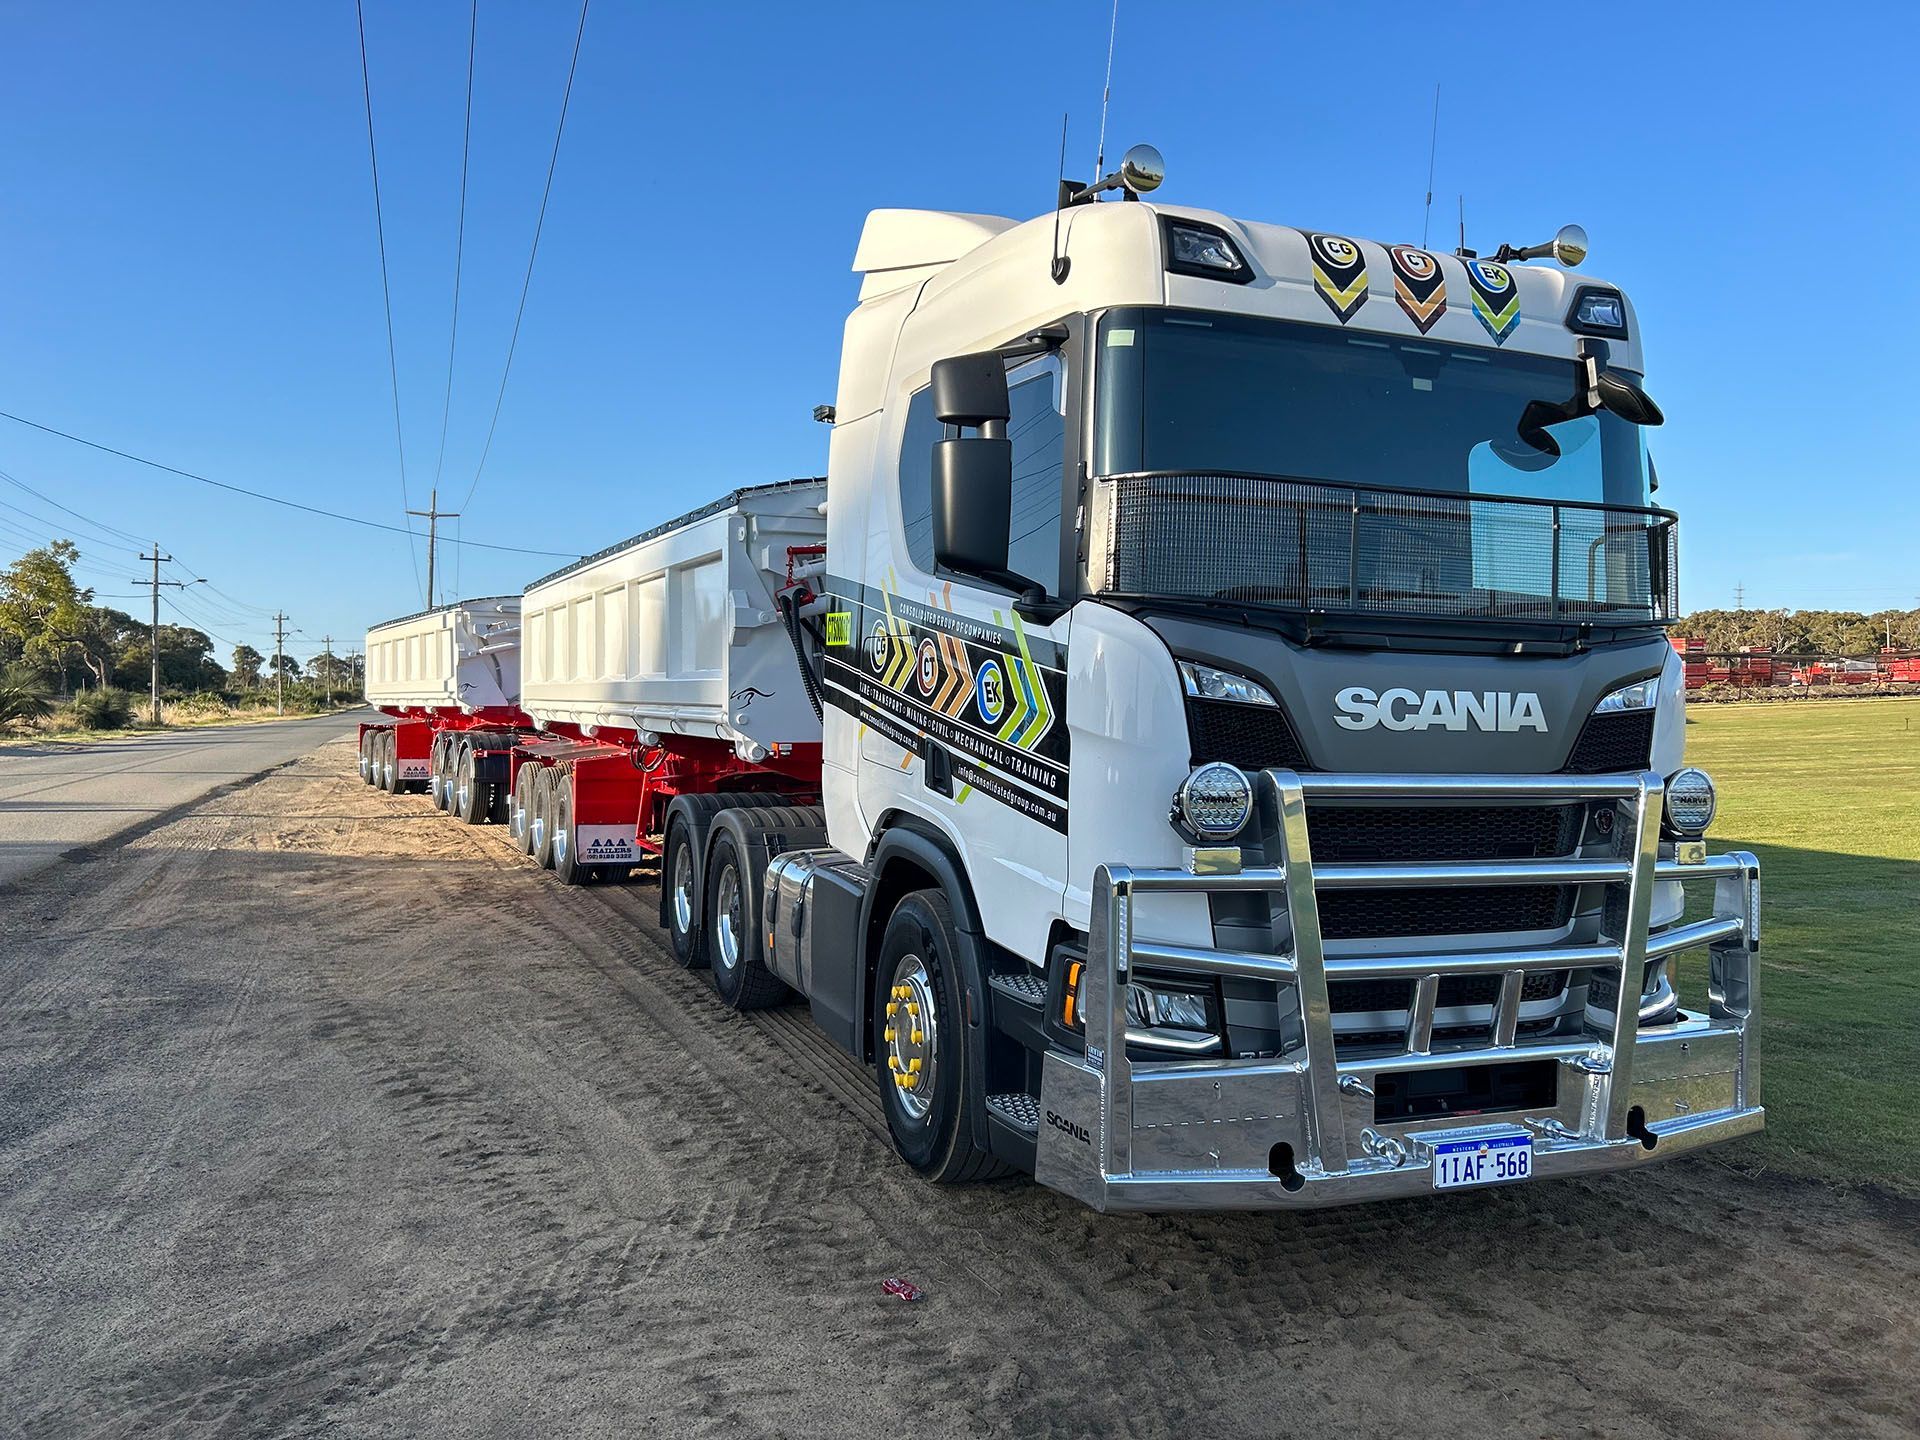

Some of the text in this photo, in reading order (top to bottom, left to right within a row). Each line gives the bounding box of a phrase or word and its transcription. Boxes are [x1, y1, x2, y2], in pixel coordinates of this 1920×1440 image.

[1328, 241, 1352, 256] CG
[1406, 253, 1429, 268] CT
[1481, 266, 1505, 281] EK
[899, 602, 1002, 645] CONSOLIDATED GROUP OF COMPANIES
[875, 637, 886, 655] CG
[923, 656, 935, 677] CT
[983, 681, 1002, 703] EK
[1333, 686, 1548, 733] SCANIA
[872, 688, 903, 713] TRANSPORT
[906, 706, 927, 727] MINING
[931, 720, 949, 739] CIVIL
[954, 730, 1004, 765] MECHANICAL
[1011, 757, 1056, 788] TRAINING
[957, 763, 1057, 822] info@consolidatedgroup.com.au
[1680, 796, 1708, 804] NARVA
[1046, 1110, 1091, 1146] SCANIA
